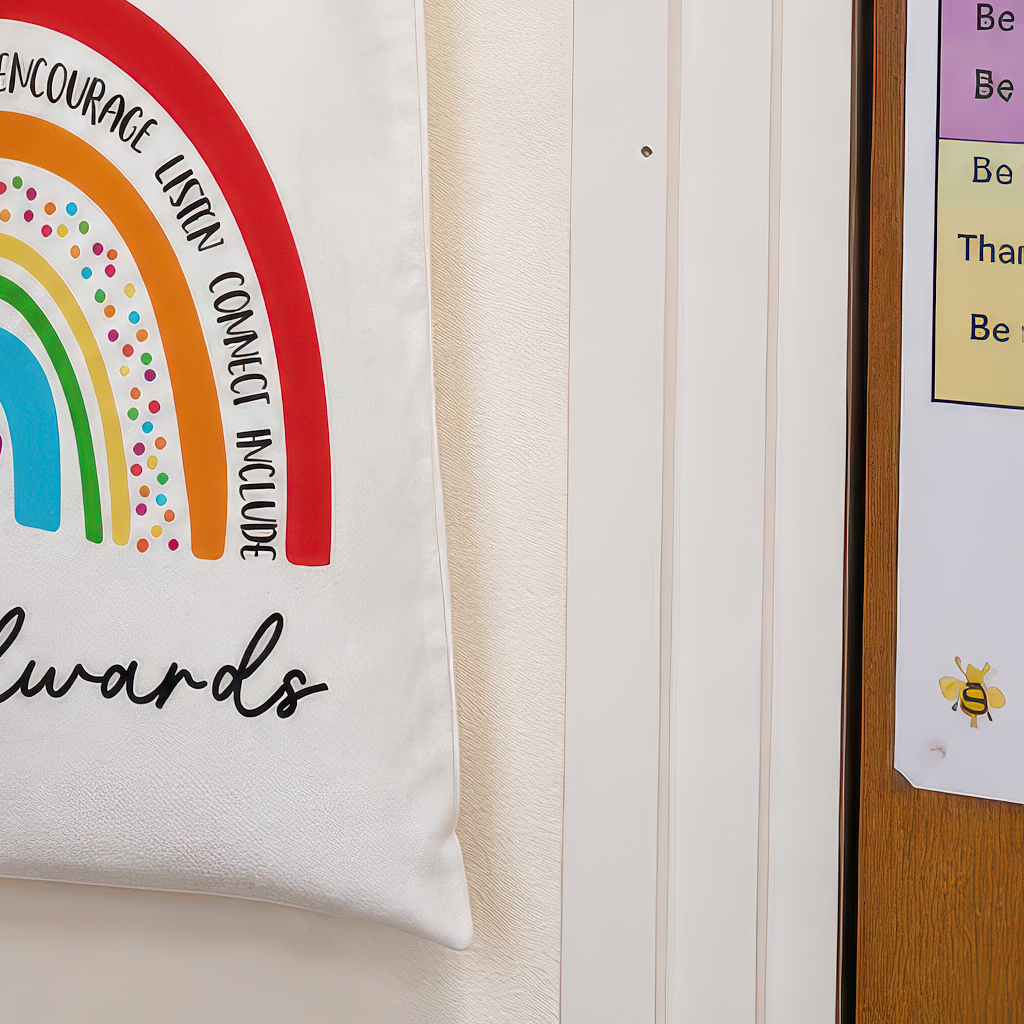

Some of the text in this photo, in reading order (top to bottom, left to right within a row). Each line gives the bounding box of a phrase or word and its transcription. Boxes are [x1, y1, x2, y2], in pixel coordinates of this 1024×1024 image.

[976, 2, 1015, 32] Be
[974, 68, 1015, 103] Be
[972, 156, 1013, 185] Be
[154, 154, 224, 252] LISTEN
[208, 271, 271, 406] CONNECT
[970, 313, 1010, 343] Be
[235, 428, 278, 561] INCLUDE
